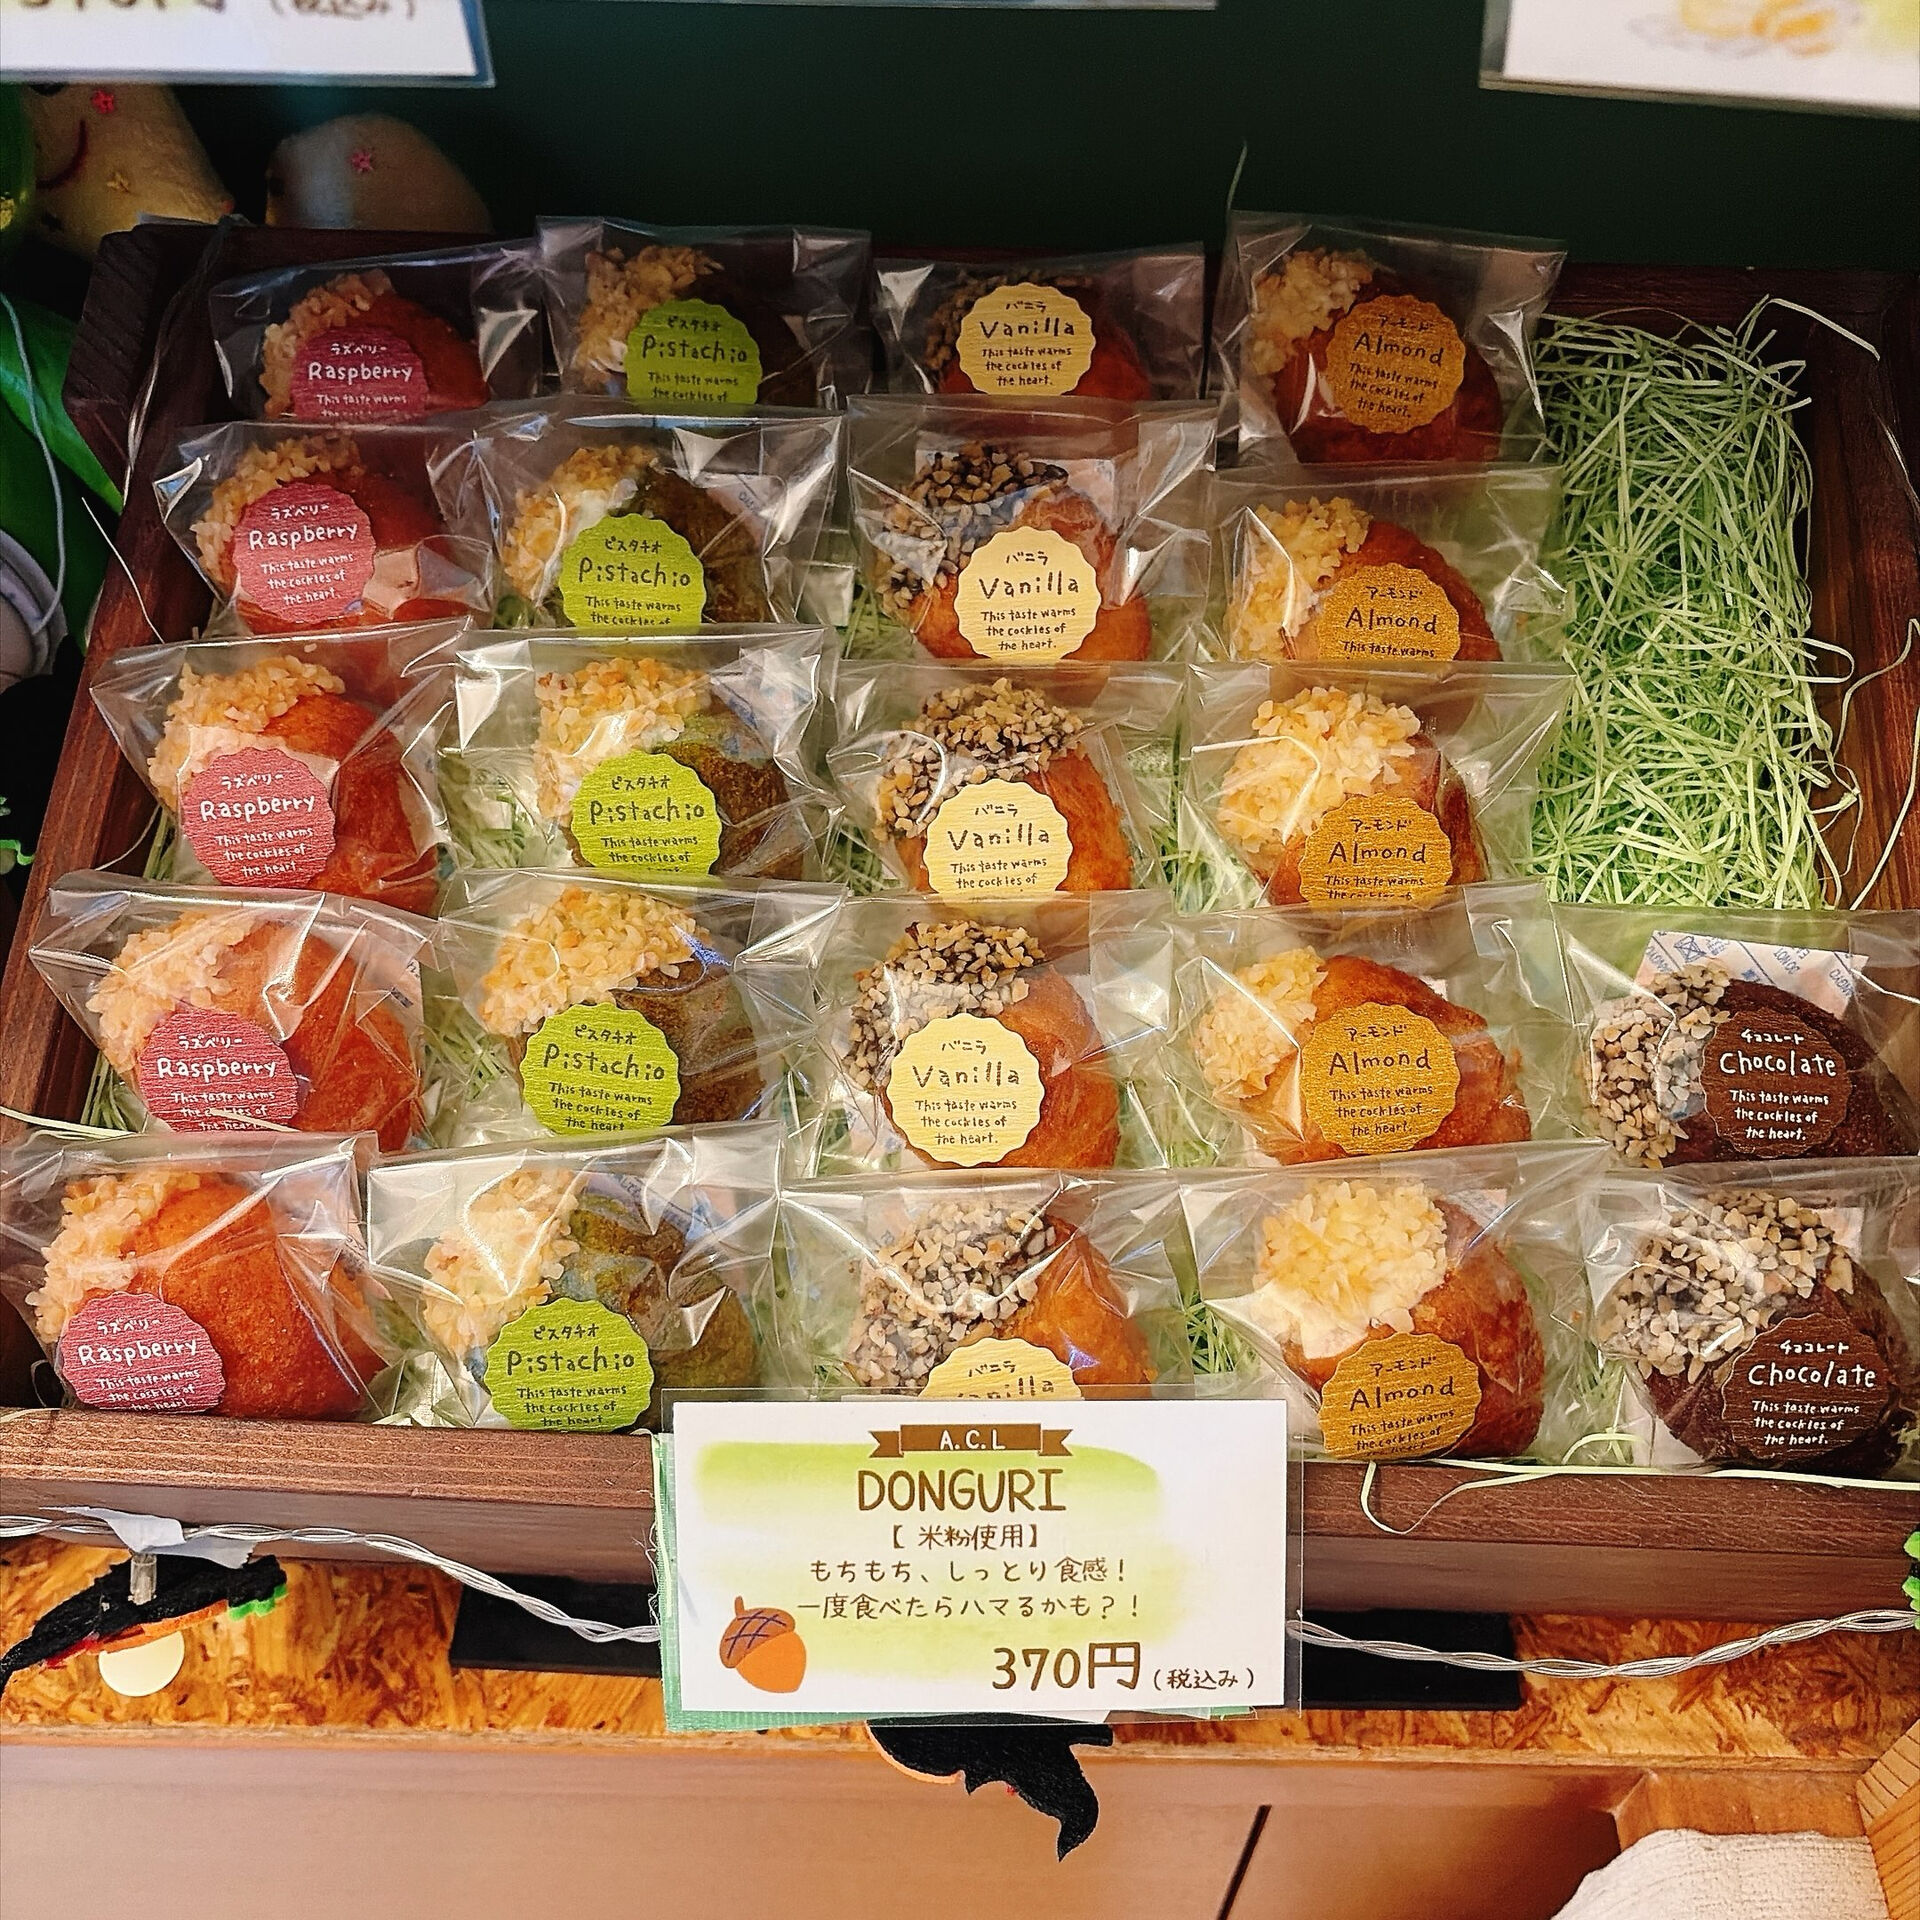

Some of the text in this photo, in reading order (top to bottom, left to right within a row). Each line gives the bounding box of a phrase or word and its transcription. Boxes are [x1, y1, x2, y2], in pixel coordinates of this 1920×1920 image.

[1006, 300, 1046, 312] バニラ
[980, 317, 1075, 338] Vanilla
[331, 343, 387, 355] ラズベリー
[642, 334, 747, 363] Pistachio
[982, 346, 1072, 358] This taste warms
[1353, 332, 1444, 367] Almond
[309, 361, 412, 385] Raspberry
[985, 361, 1047, 371] the cockles
[996, 374, 1052, 386] the heart.
[271, 502, 330, 520] ラズベリー
[249, 524, 358, 550] Raspberry
[605, 535, 662, 552] ピスタチオ
[261, 553, 353, 574] This taste warms
[1006, 551, 1048, 566] バニラ
[578, 557, 691, 588] Pistachio
[267, 573, 332, 589] the cockles
[979, 570, 1079, 600] Vanilla
[283, 593, 301, 605] the
[585, 595, 682, 612] This taste warms
[590, 611, 610, 625] the
[981, 607, 1076, 622] This taste warms
[1345, 606, 1437, 635] Almond
[986, 624, 1050, 636] the cockles
[998, 638, 1056, 651] the heart.
[1340, 640, 1435, 658] This taste warms
[221, 773, 284, 790] ラズベリー
[612, 775, 671, 791] ピスタチオ
[200, 795, 315, 823] Raspberry
[590, 797, 705, 826] Pistachio
[975, 804, 1018, 817] バニラ
[1350, 819, 1414, 833] アーモンド
[214, 828, 314, 847] This taste warms
[601, 836, 699, 849] This taste warms
[948, 822, 1050, 851] Vanilla
[224, 846, 292, 861] the cockles
[609, 851, 677, 863] the cockles
[1328, 841, 1426, 864] Almond
[241, 864, 261, 878] the
[950, 858, 1047, 874] This taste warms
[956, 876, 1023, 889] the cockles
[1325, 875, 1424, 887] This taste warms
[1328, 889, 1347, 900] the
[574, 1023, 637, 1045] ピスタチオ
[1344, 1024, 1408, 1041] アーモンド
[178, 1032, 243, 1050] ラズベリー
[942, 1040, 987, 1055] バニラ
[156, 1056, 277, 1083] Raspberry
[543, 1043, 666, 1081] Pistachio
[1328, 1049, 1431, 1076] Almond
[1719, 1050, 1837, 1077] Chocolate
[912, 1060, 1020, 1088] Vanilla
[549, 1082, 653, 1105] This taste warms
[1329, 1086, 1433, 1102] This taste warms
[1729, 1090, 1830, 1105] This taste warms
[553, 1098, 623, 1118] the cockles
[914, 1099, 1017, 1112] This taste warms
[1335, 1105, 1406, 1118] the cockles
[565, 1116, 586, 1129] the
[921, 1116, 991, 1128] the cockles
[1734, 1107, 1802, 1122] the cockles
[1350, 1120, 1412, 1137] the heart.
[1745, 1126, 1806, 1141] the heart.
[935, 1131, 999, 1145] the heart.
[96, 1320, 162, 1335] ラズベリー
[533, 1323, 600, 1341] ピスタチオ
[77, 1339, 198, 1367] Raspberry
[506, 1345, 635, 1376] Pistachio
[968, 1361, 1016, 1378] バニラ
[1370, 1355, 1438, 1377] アーモンド
[1748, 1360, 1876, 1388] Chocolate
[516, 1386, 627, 1400] This taste warms
[1349, 1376, 1455, 1411] Almond
[524, 1401, 600, 1414] the cockles
[1751, 1400, 1860, 1414] This taste warms
[541, 1417, 563, 1427] the
[1350, 1410, 1455, 1436] This taste warms
[1753, 1416, 1826, 1430] the cockles
[1378, 1432, 1427, 1447] cockles
[1763, 1433, 1829, 1446] the heart.
[857, 1468, 1068, 1513] DONGURI
[808, 1557, 1129, 1586] もちもち、しっとり食感！
[991, 1640, 1143, 1691] 370円
